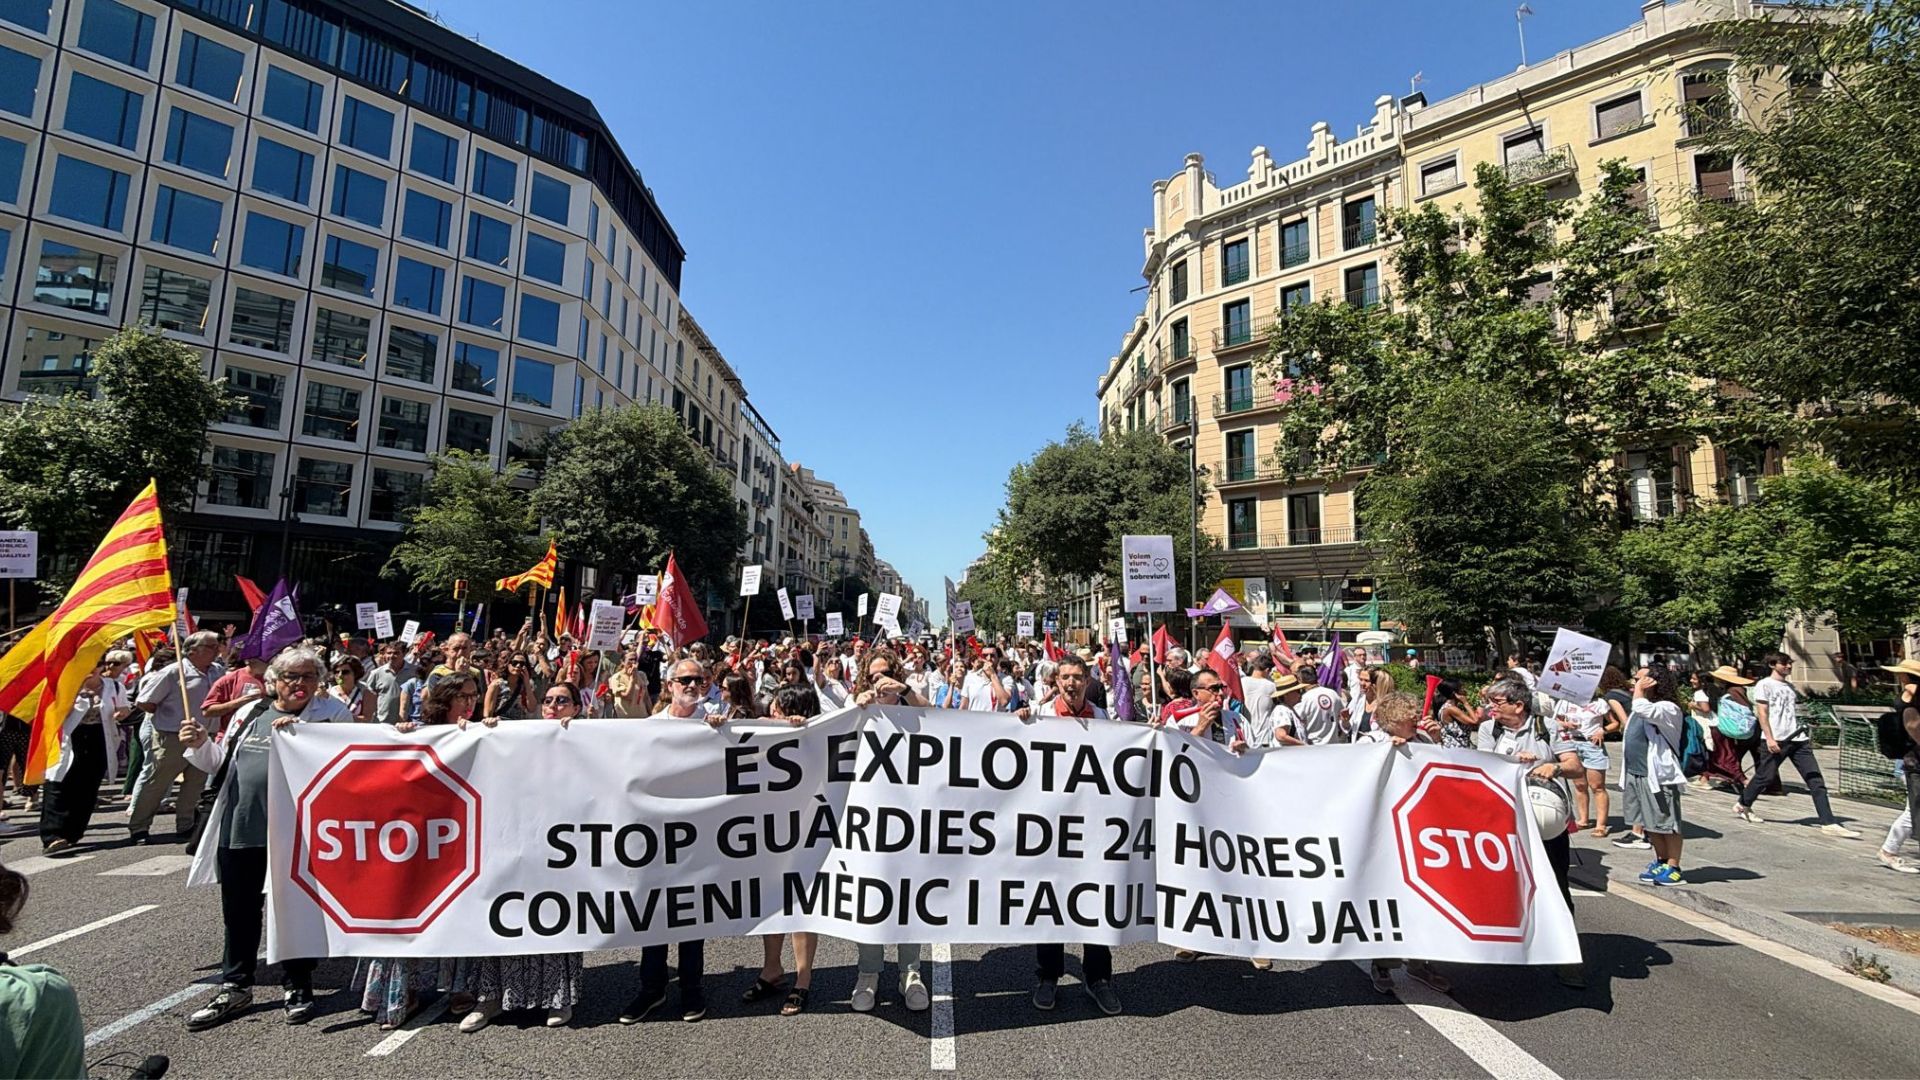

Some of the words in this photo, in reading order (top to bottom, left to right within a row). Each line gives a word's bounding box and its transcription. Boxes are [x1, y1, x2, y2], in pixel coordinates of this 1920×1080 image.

[724, 732, 804, 796] ÉS
[827, 730, 1201, 804] EXPLOTACIÓ
[316, 818, 461, 863] STOP
[547, 821, 698, 869] STOP
[716, 794, 997, 859] GUÀRDIES
[1015, 813, 1085, 859] DE
[1103, 817, 1156, 861] 24
[1174, 822, 1345, 879] HORES!
[488, 877, 762, 938] CONVENI
[783, 861, 950, 926] MÈDIC
[968, 879, 980, 926] I
[1000, 880, 1290, 943] FACULTATIU
[1307, 898, 1404, 944] JA!!
